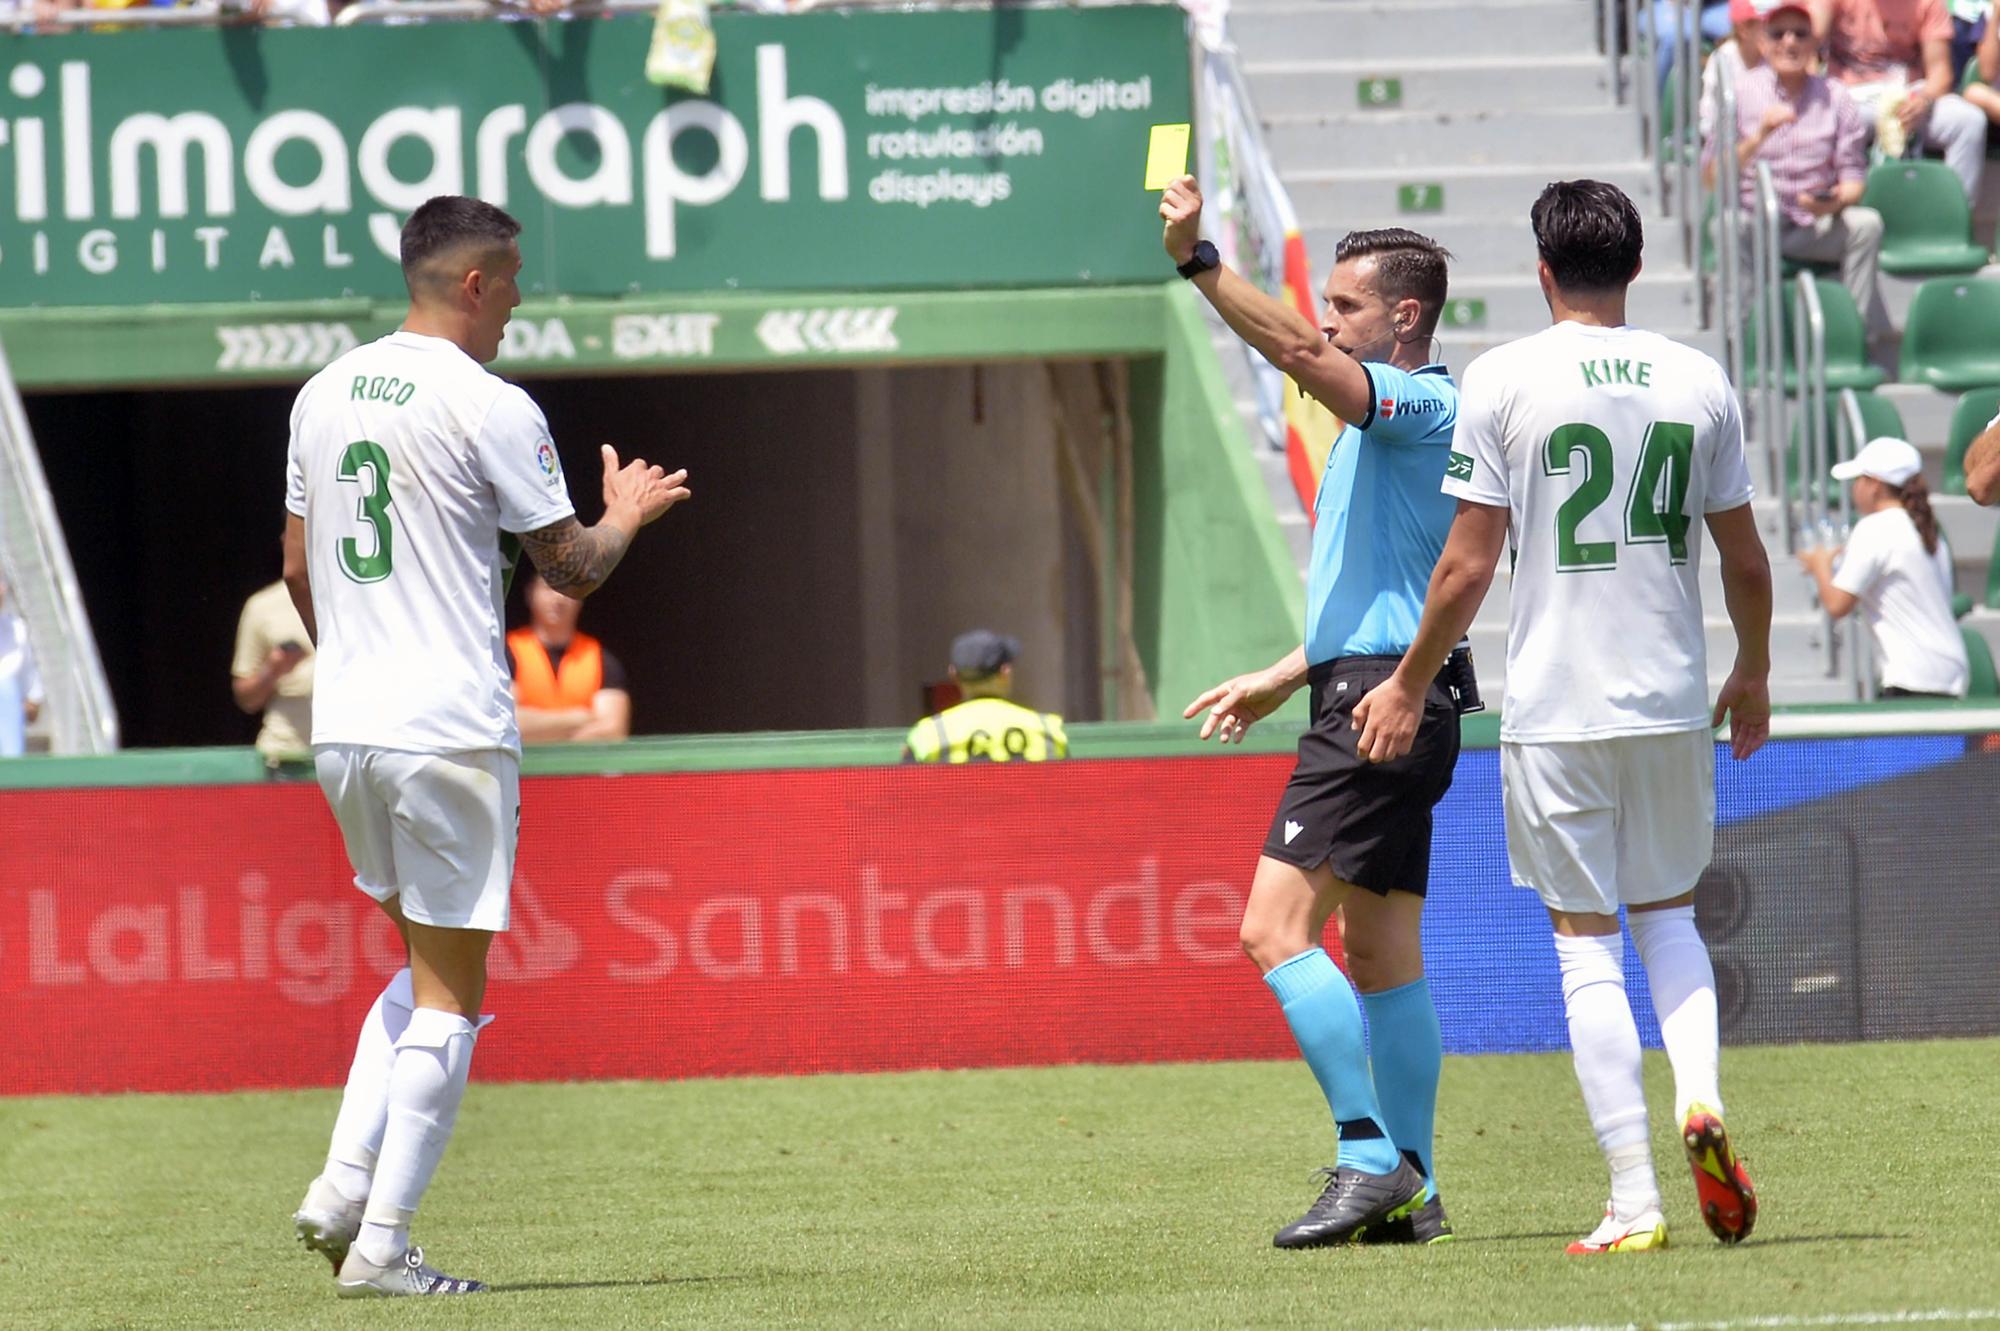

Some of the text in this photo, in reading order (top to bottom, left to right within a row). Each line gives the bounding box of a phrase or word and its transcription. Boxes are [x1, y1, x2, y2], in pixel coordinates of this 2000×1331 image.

[865, 76, 1152, 121] impresión digital
[0, 43, 848, 262] ilmagraph
[867, 122, 1044, 160] rotulación
[868, 168, 1012, 208] displays
[1411, 184, 1429, 210] 7
[0, 223, 353, 275] IGITAL
[499, 318, 575, 360] DA
[613, 312, 719, 357] EXIT
[350, 374, 416, 407] ROCO
[1579, 358, 1653, 388] KIKE
[336, 440, 394, 585] 3
[1542, 421, 1695, 574] 24
[603, 854, 1246, 983] Santande
